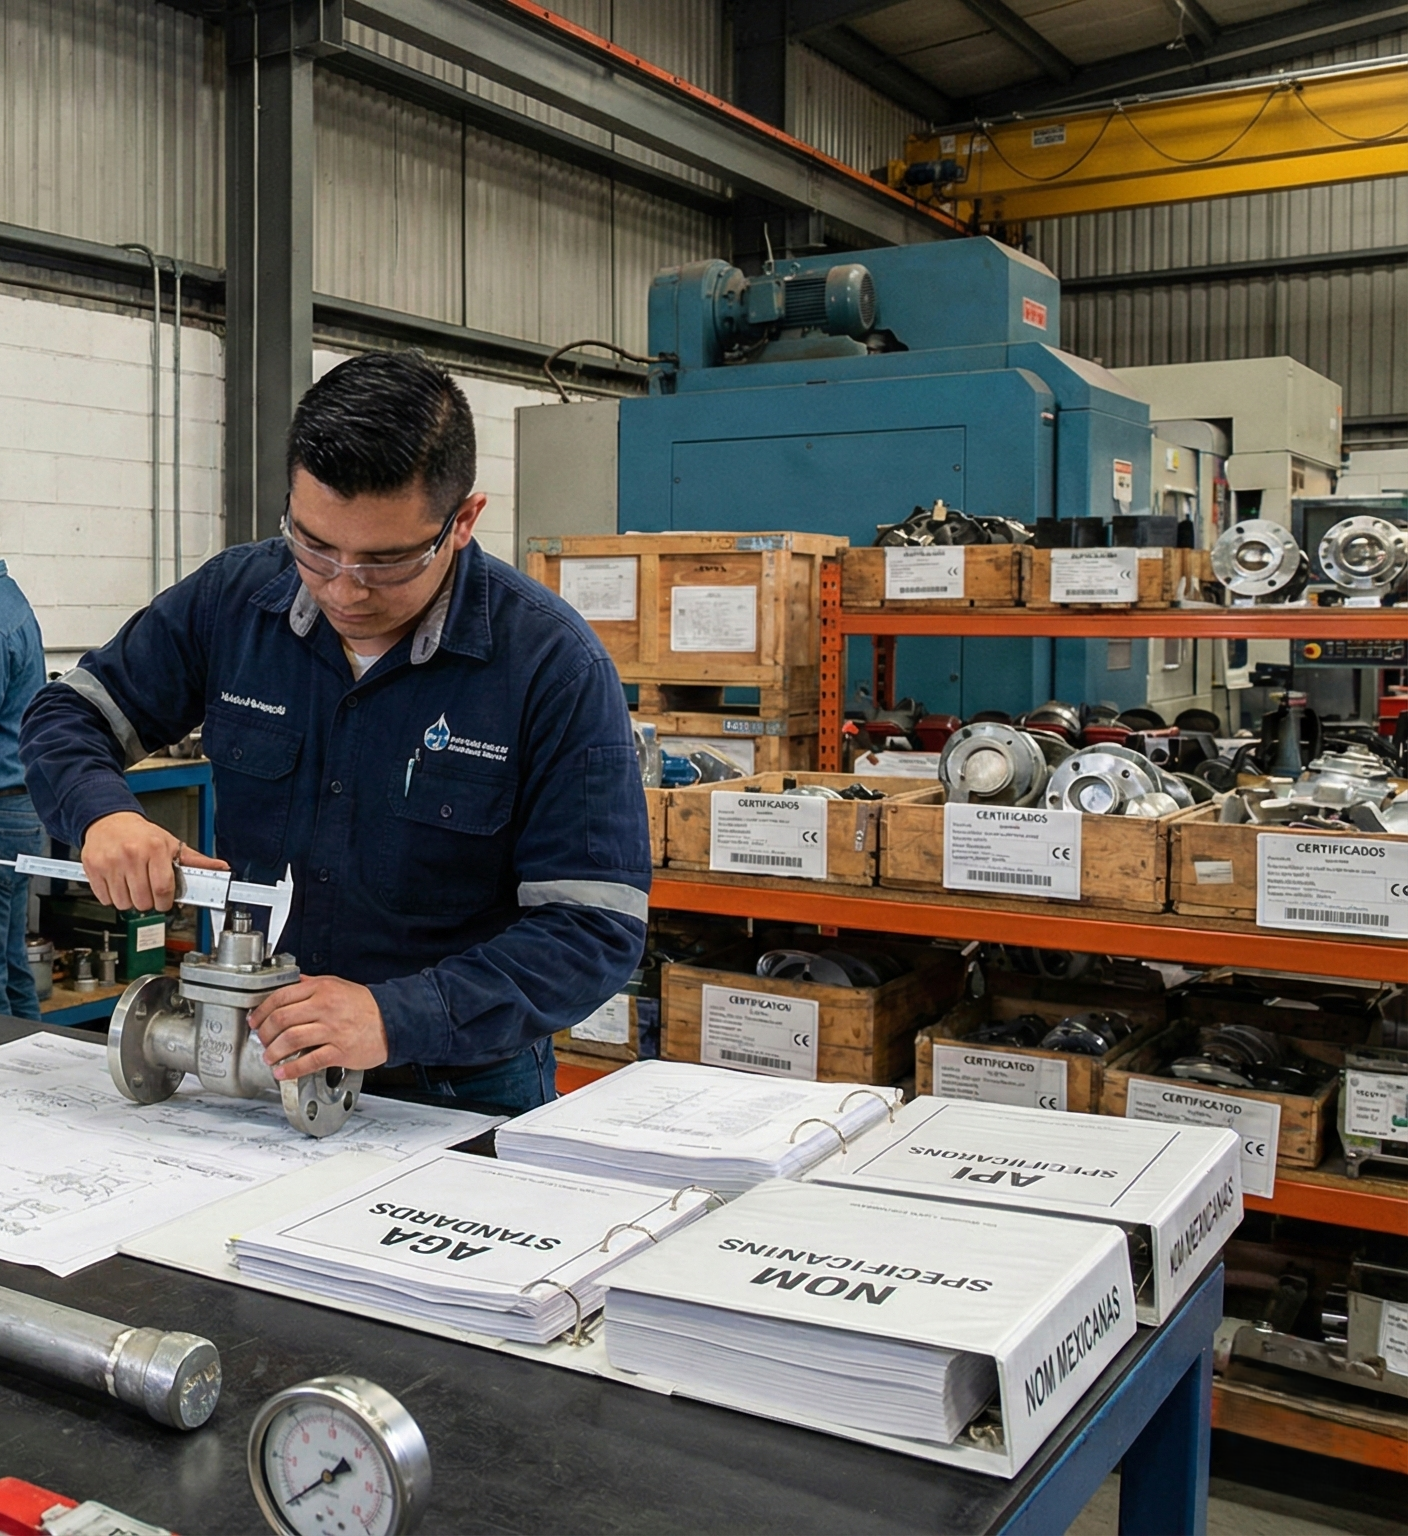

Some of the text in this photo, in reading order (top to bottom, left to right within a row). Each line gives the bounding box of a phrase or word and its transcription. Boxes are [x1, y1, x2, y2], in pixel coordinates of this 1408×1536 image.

[976, 811, 1048, 824] CERTIFICADOS
[1052, 847, 1070, 860] CE
[1296, 843, 1386, 857] CERTIFICADOS
[1245, 1141, 1266, 1157] CE
[950, 1166, 1046, 1188] API
[368, 1202, 562, 1251] STANDARDS
[379, 1226, 494, 1261] AGA
[750, 1266, 898, 1306] NOM
[1025, 1285, 1121, 1418] NOM MEXICANAS
